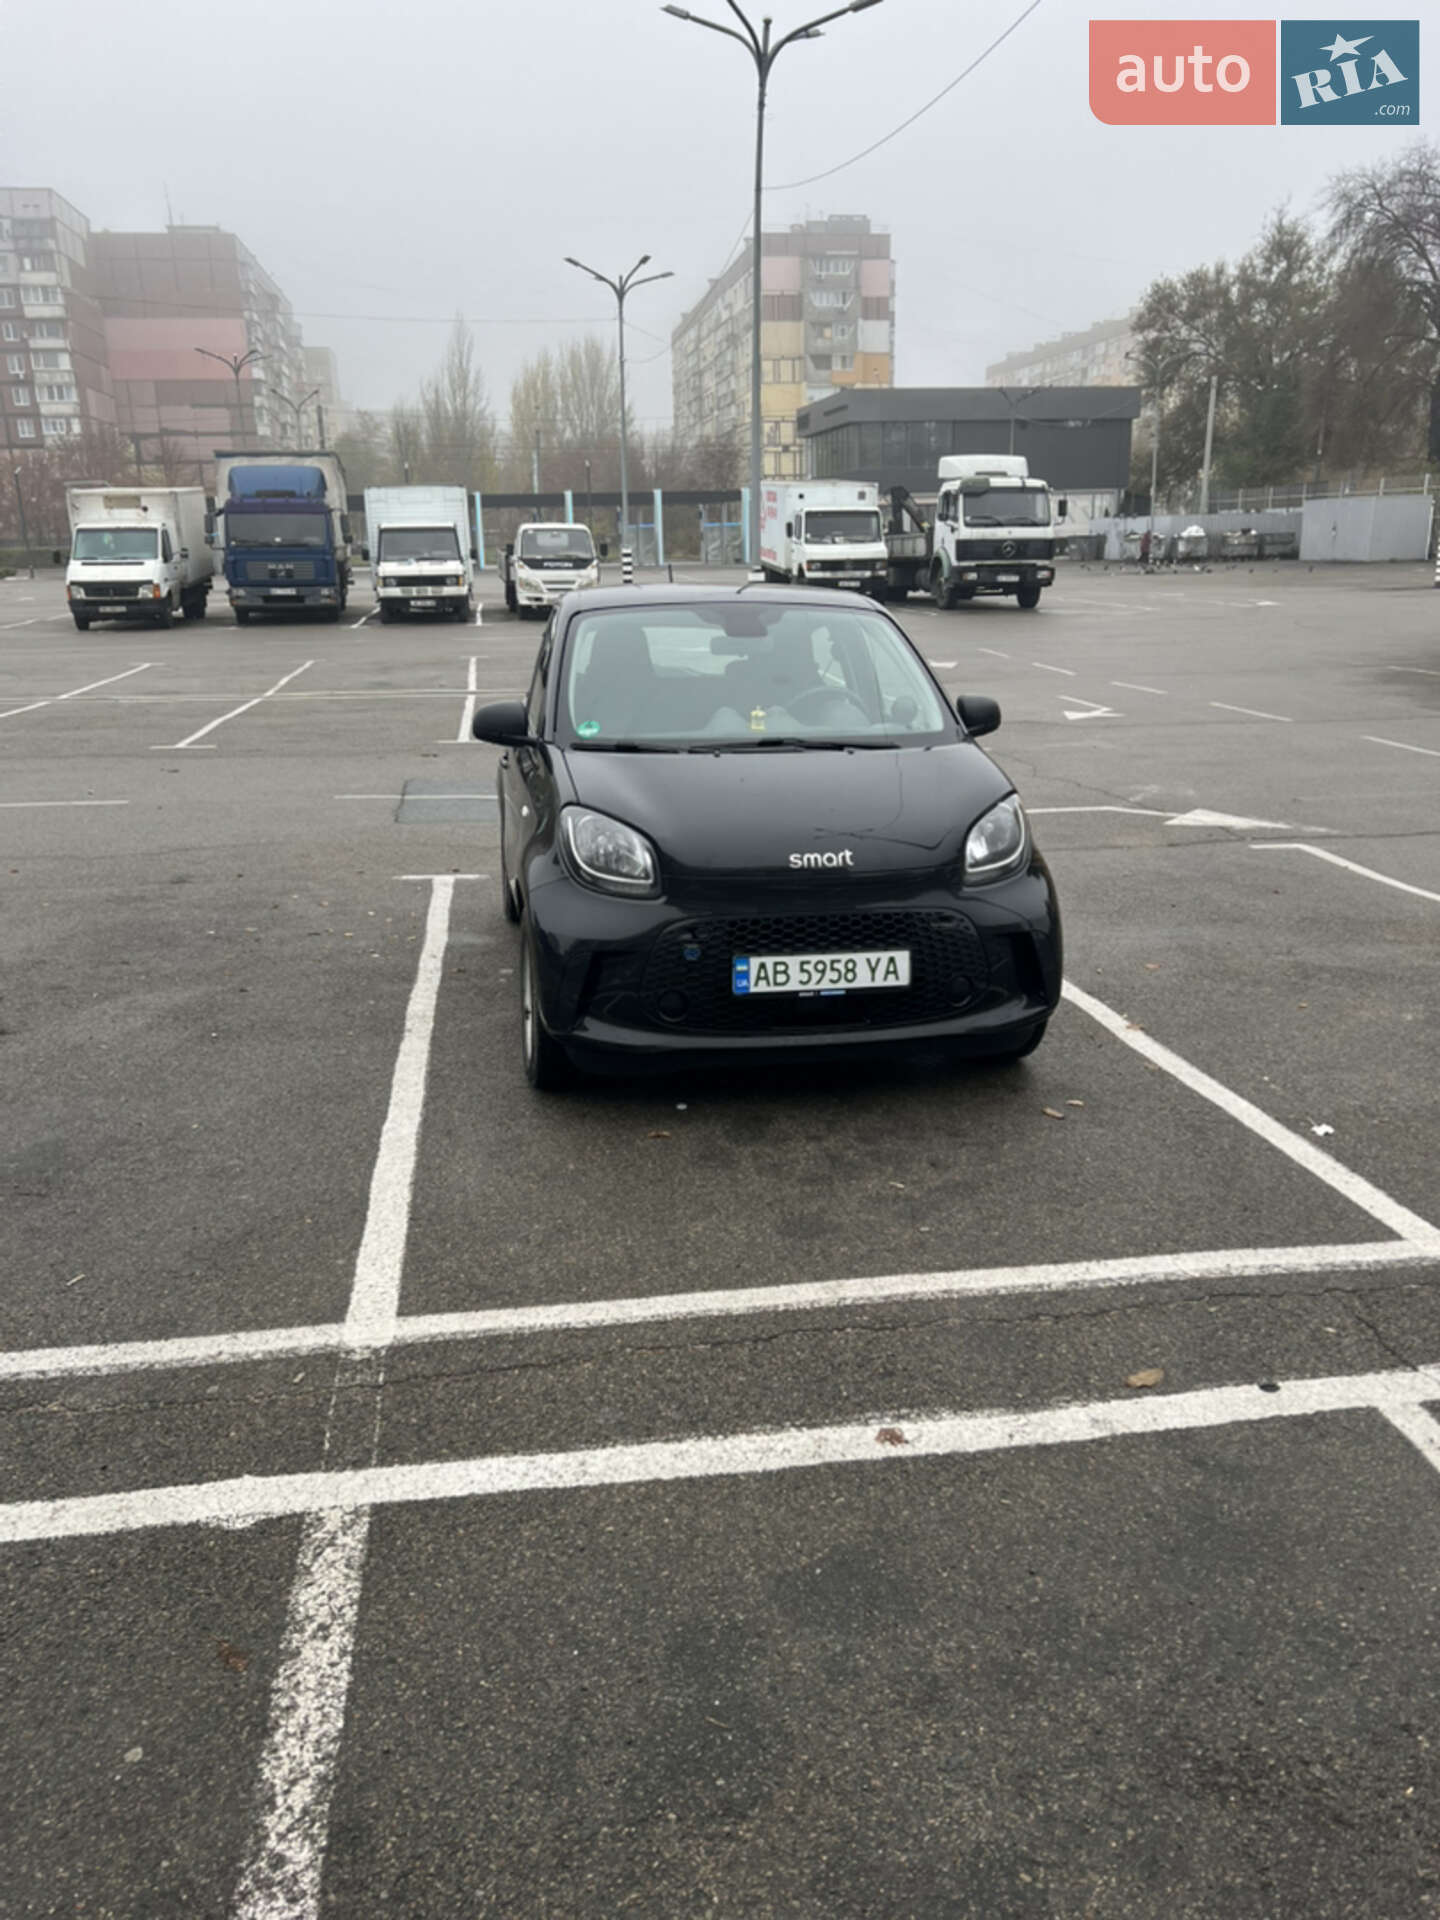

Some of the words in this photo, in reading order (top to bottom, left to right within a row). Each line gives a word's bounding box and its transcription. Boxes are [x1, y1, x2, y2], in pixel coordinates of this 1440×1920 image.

[789, 849, 854, 868] smart
[754, 960, 790, 987] AB
[798, 957, 857, 986] 5958
[866, 956, 899, 982] YA
